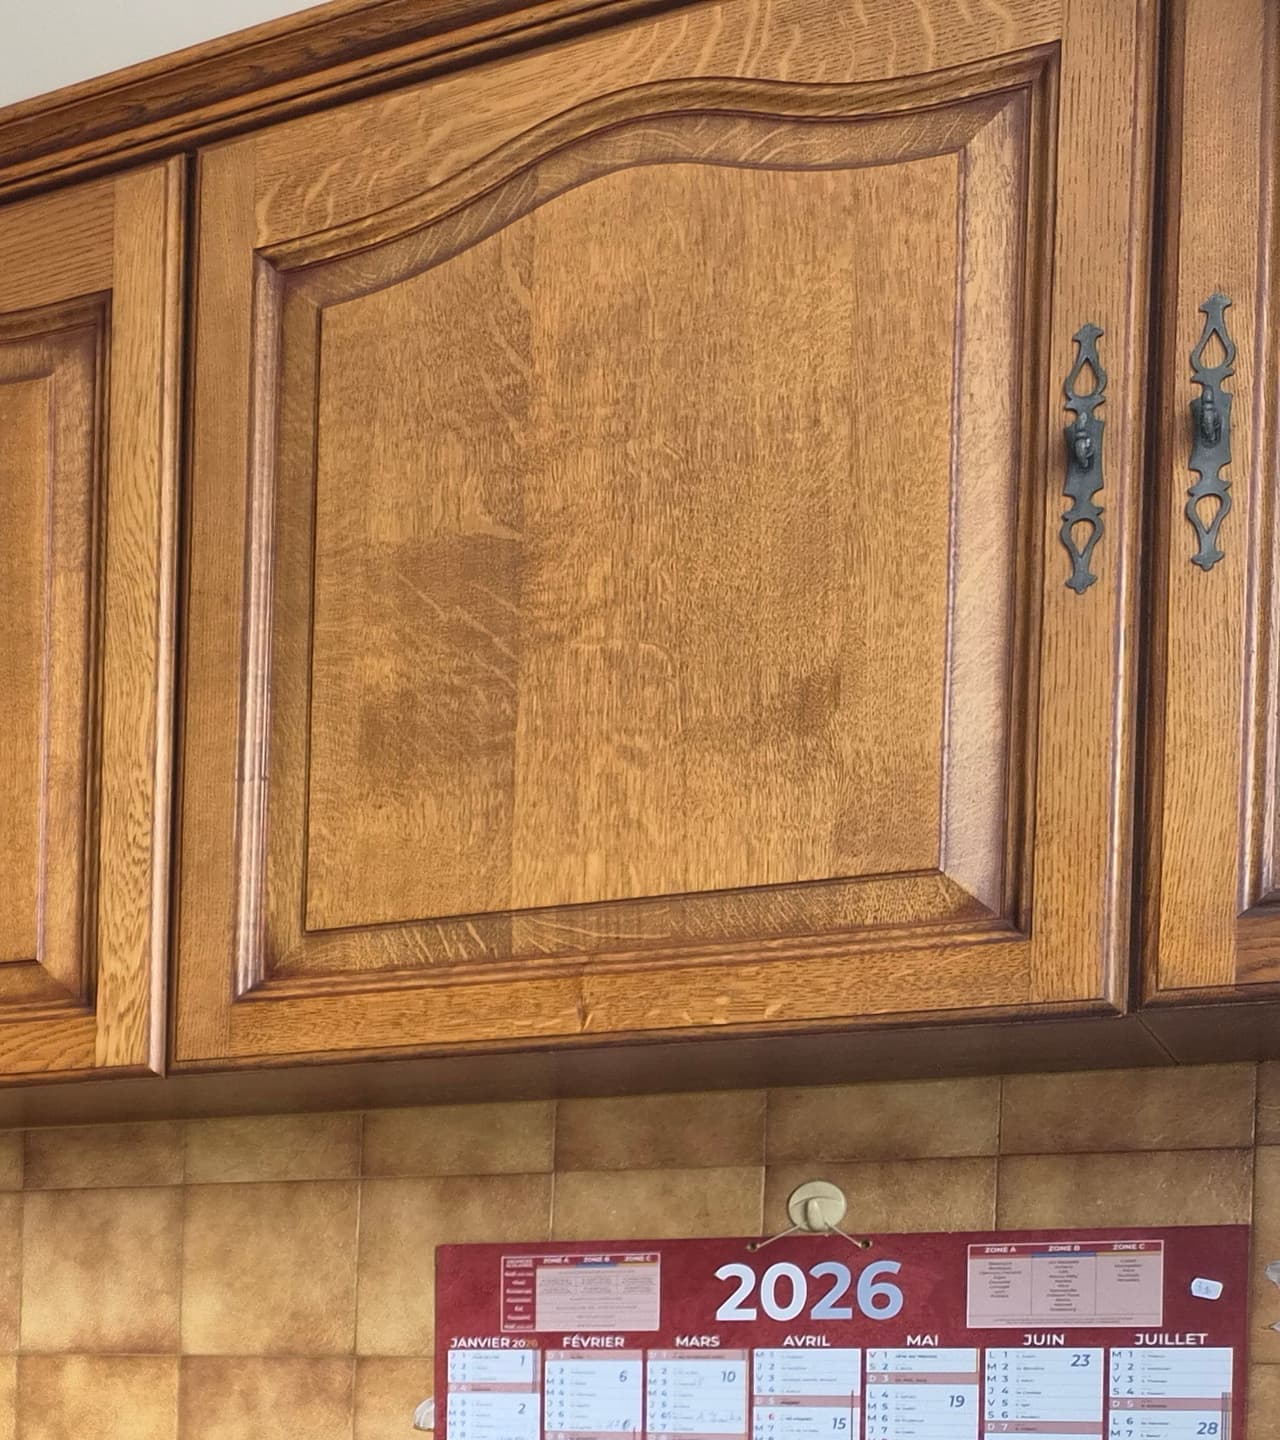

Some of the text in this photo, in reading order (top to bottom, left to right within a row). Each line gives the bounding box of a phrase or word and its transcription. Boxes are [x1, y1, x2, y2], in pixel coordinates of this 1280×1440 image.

[714, 1260, 903, 1321] 2026
[451, 1337, 510, 1348] JANVIER
[563, 1334, 624, 1347] FÉVRIER
[676, 1336, 720, 1347] MARS
[783, 1335, 830, 1346] AVRIL
[907, 1335, 938, 1346] MAI
[1023, 1334, 1064, 1345] JUIN
[1134, 1333, 1208, 1345] JUILLET
[521, 1355, 525, 1366] 1
[1071, 1354, 1090, 1367] 23
[1114, 1363, 1134, 1371] J 2
[619, 1371, 627, 1382] 6
[722, 1371, 736, 1382] 10
[950, 1395, 965, 1408] 19
[518, 1403, 526, 1414] 2
[833, 1417, 846, 1430] 15
[1197, 1422, 1218, 1435] 28
